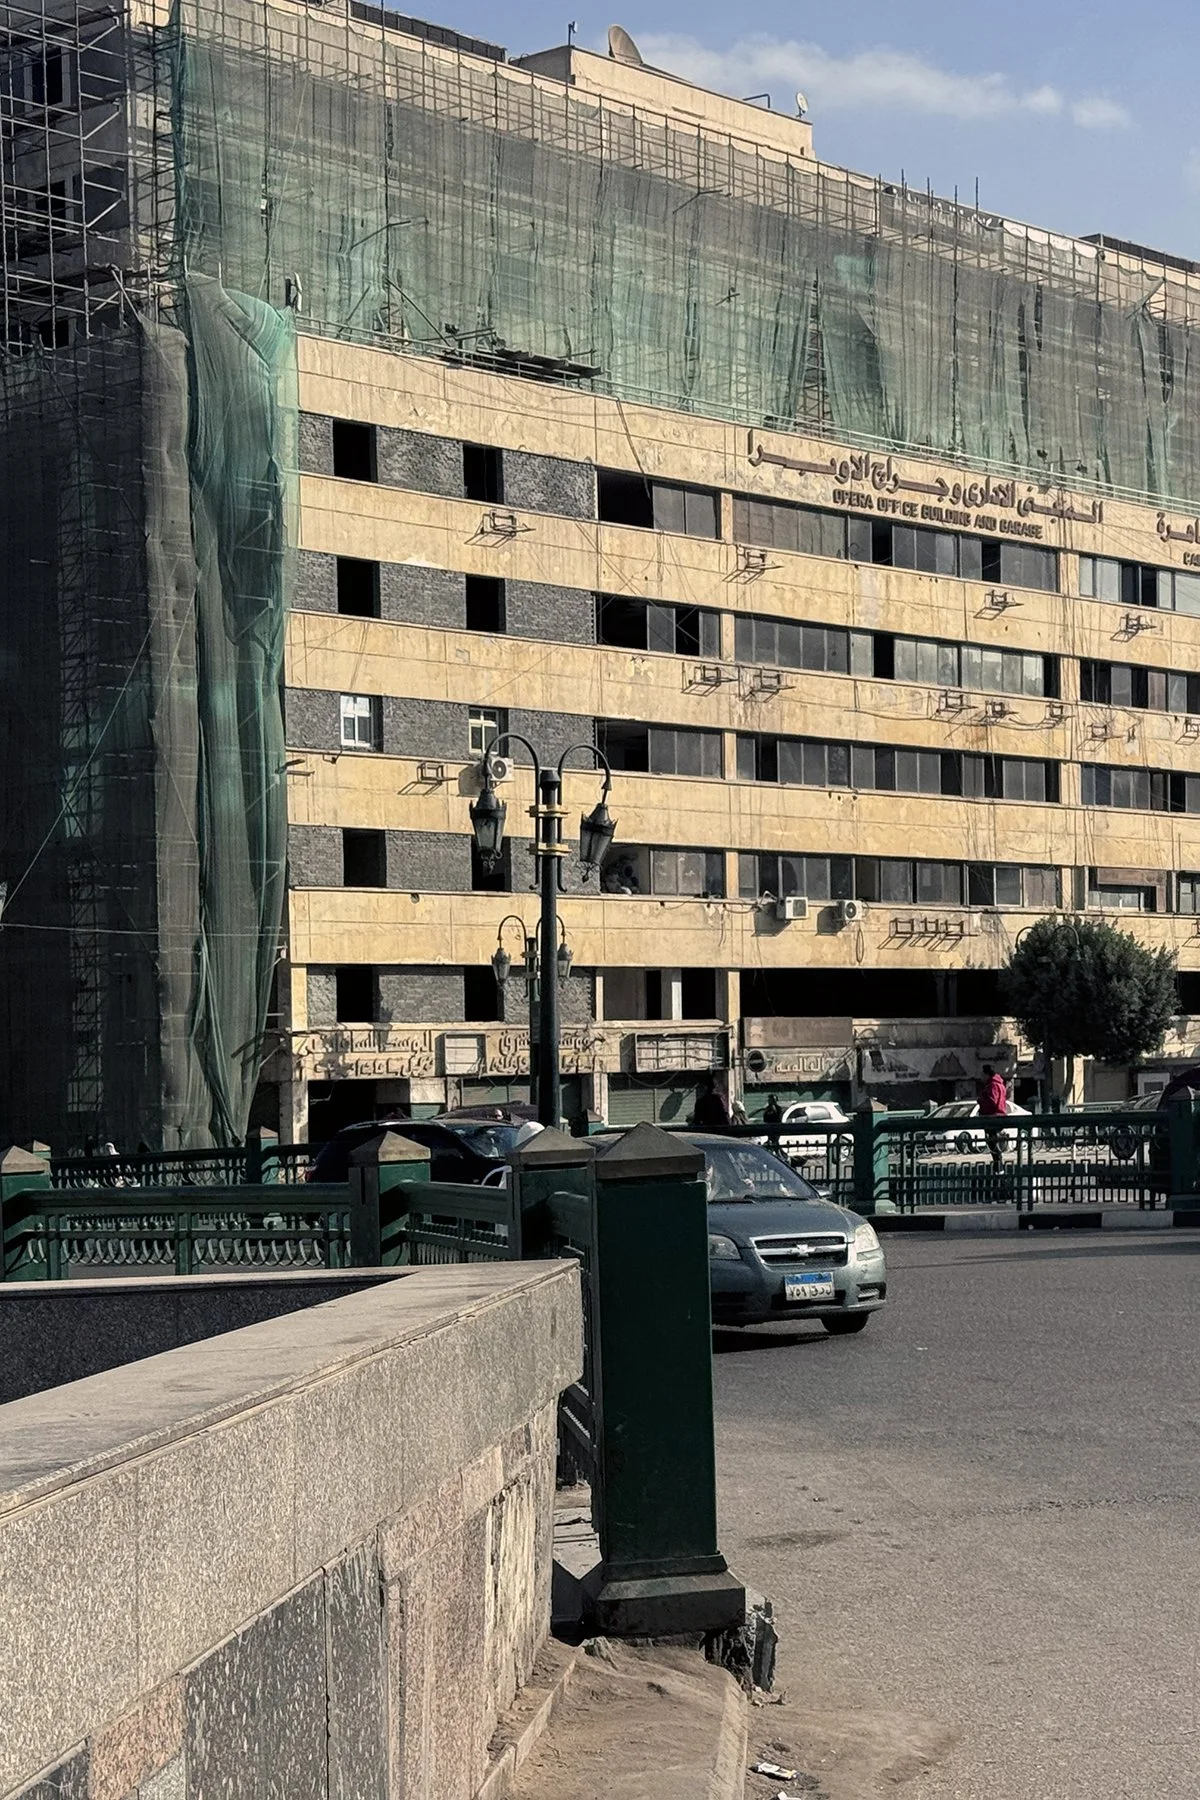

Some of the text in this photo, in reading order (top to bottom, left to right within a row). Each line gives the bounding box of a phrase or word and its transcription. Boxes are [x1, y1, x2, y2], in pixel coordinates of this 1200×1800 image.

[832, 488, 1043, 539] OPERA OFFCE BUILDING AND GARAGE
